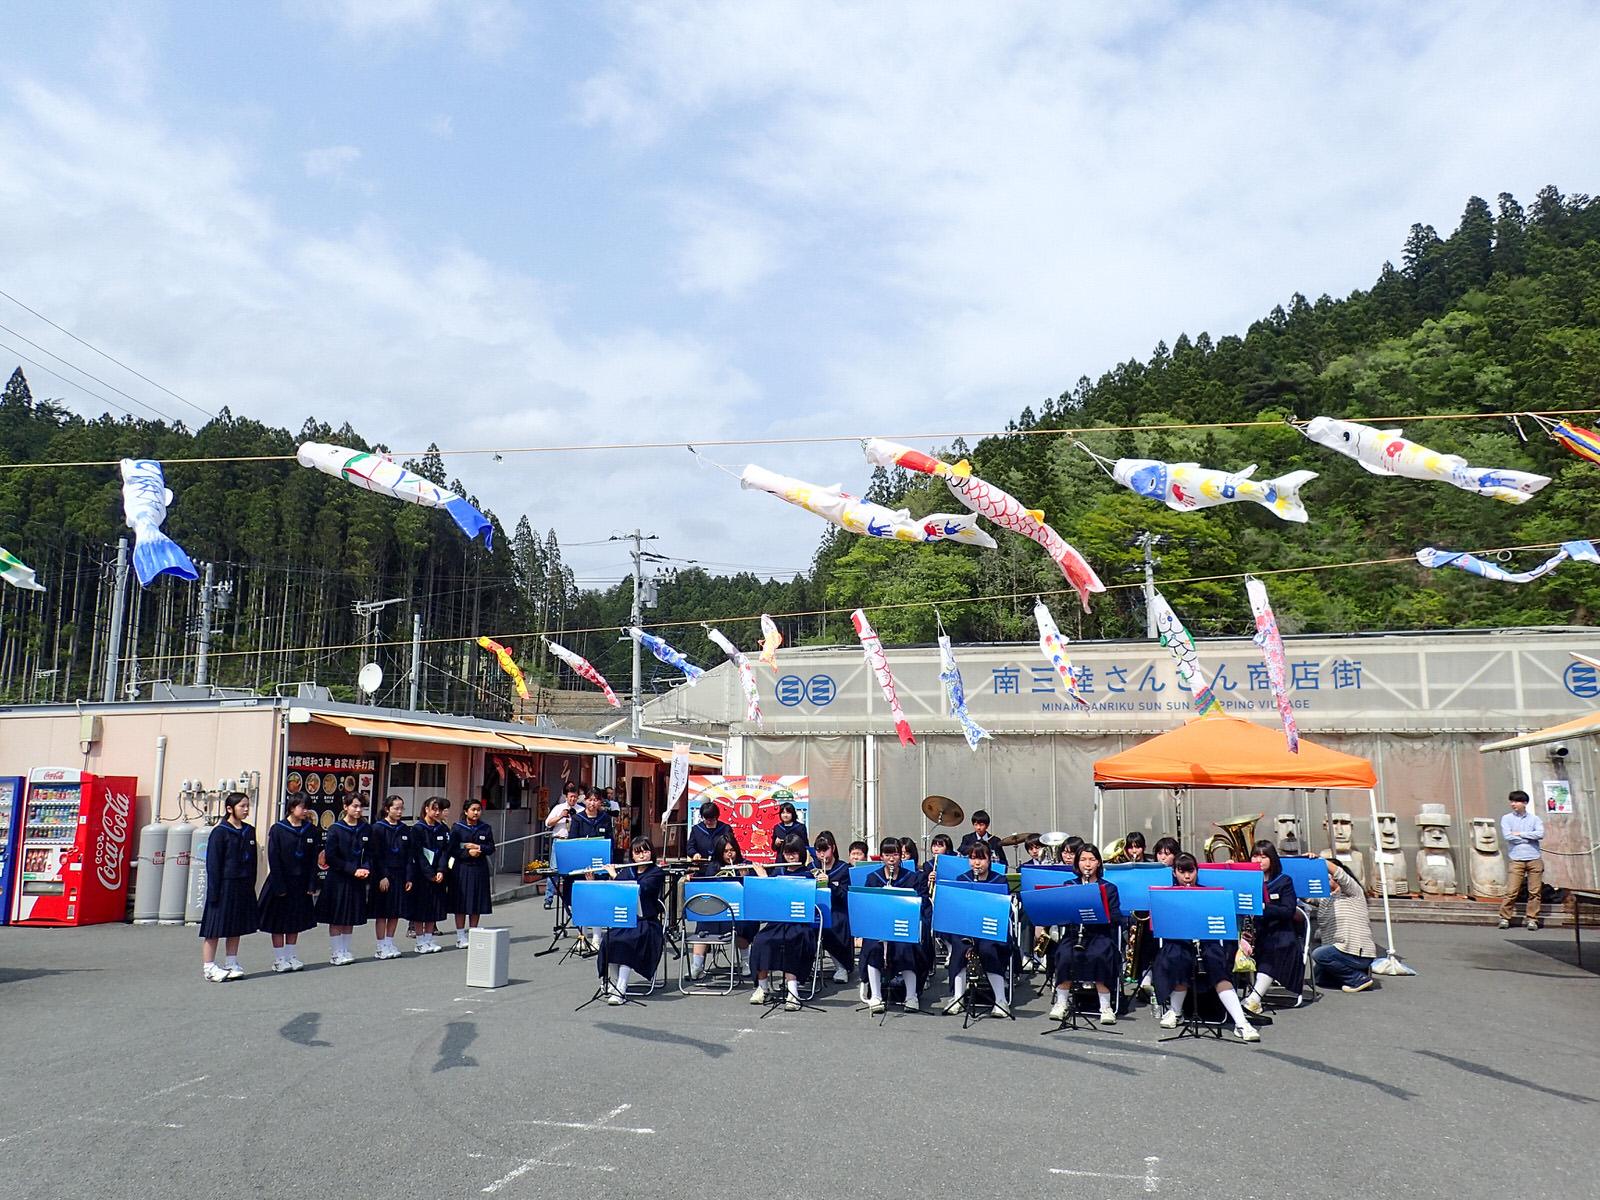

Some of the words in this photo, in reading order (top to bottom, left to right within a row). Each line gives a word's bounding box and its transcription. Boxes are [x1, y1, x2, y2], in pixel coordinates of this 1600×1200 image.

[1042, 702, 1135, 712] MINAMISANRIKU
[1138, 702, 1162, 711] SUN
[1166, 701, 1190, 711] SUN
[1194, 700, 1255, 710] PPING
[1258, 699, 1311, 709] VILAGE
[43, 770, 65, 781] Coca-Cola
[96, 786, 130, 891] Coca-Cola
[195, 868, 207, 909] エネサンス
